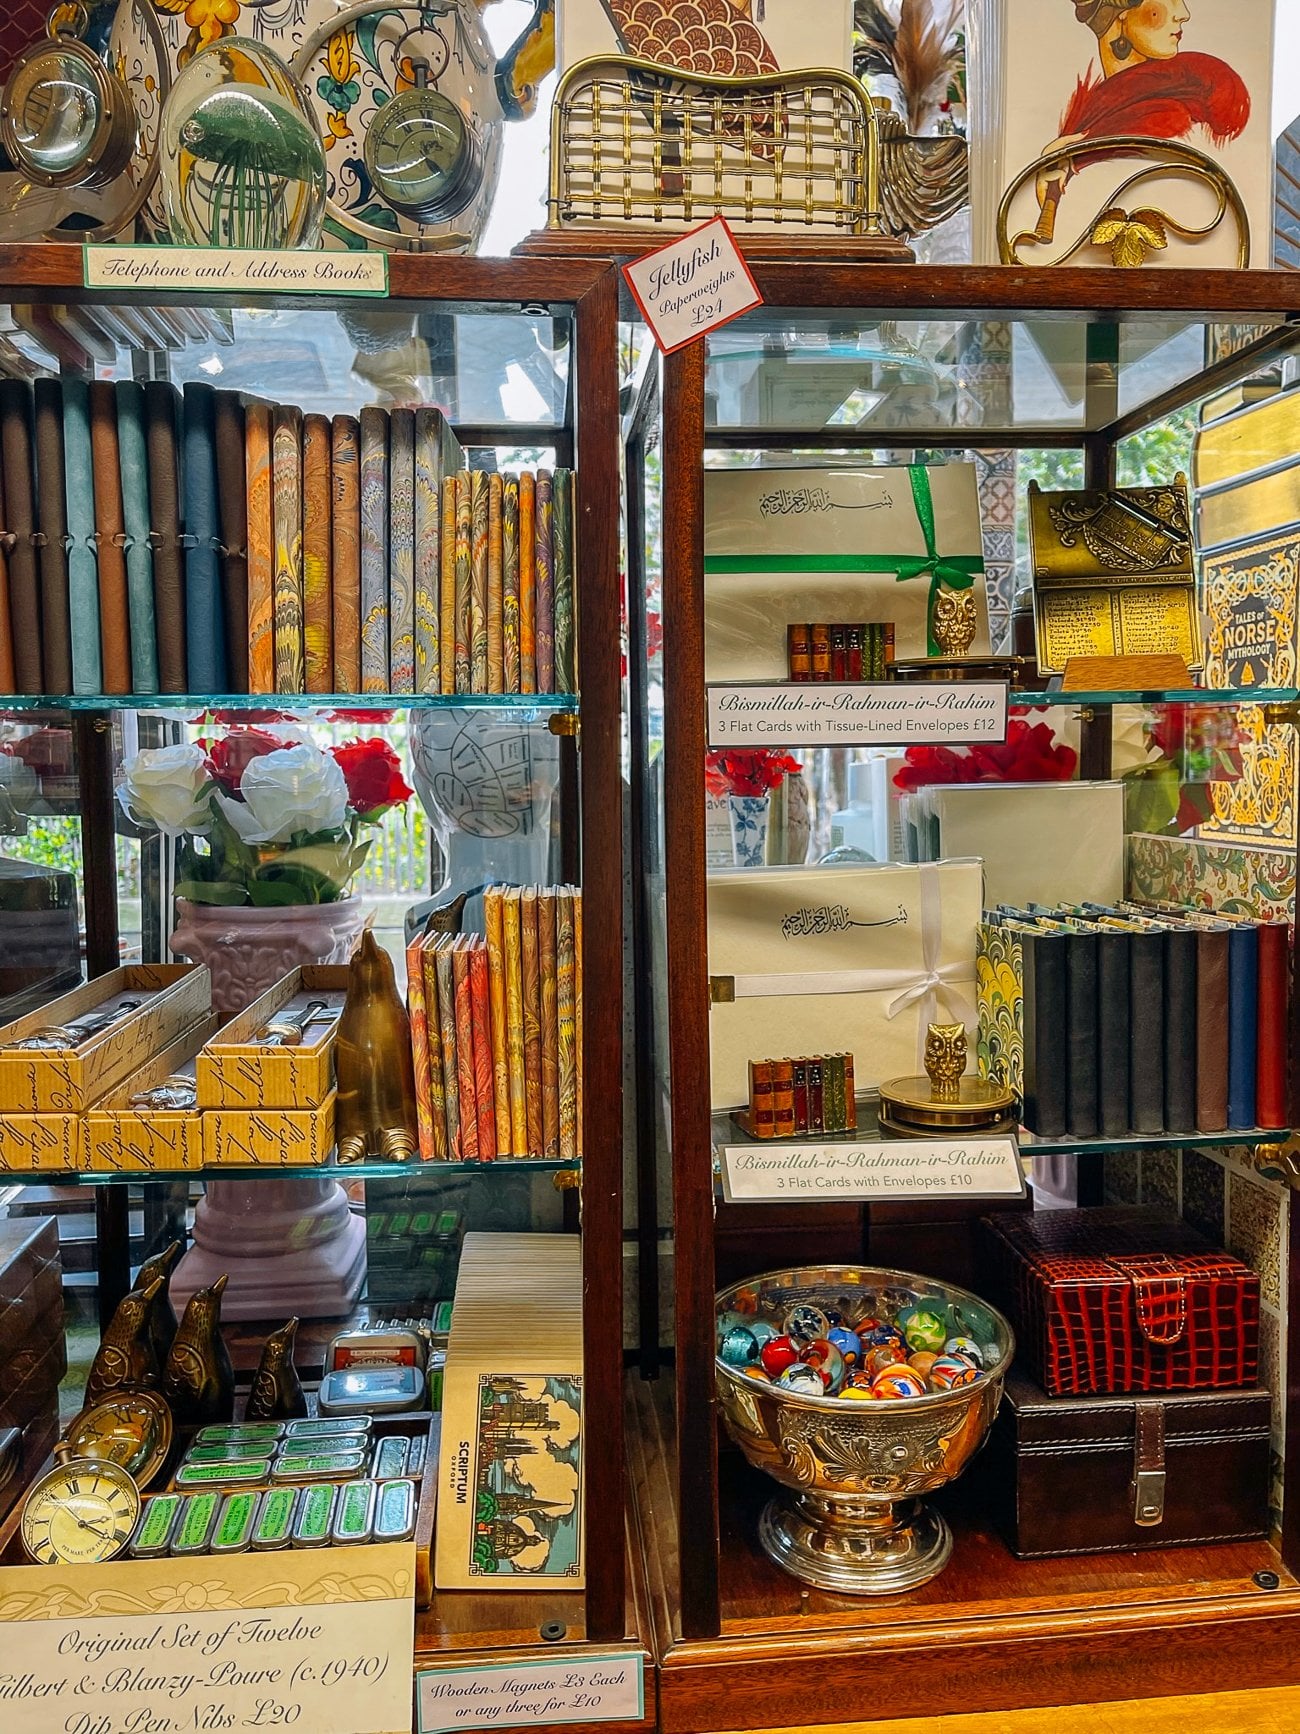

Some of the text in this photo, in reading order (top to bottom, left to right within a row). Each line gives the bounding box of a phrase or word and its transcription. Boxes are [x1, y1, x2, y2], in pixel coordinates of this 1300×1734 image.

[102, 259, 373, 283] Telephone and Address Books
[648, 239, 721, 301] Jellyfish
[659, 270, 735, 317] Paperweights
[690, 297, 723, 328] £24
[1235, 611, 1265, 624] TALES OF
[1224, 619, 1276, 649] NORSE
[1227, 643, 1271, 660] MYTHOLOGY
[718, 692, 996, 712] Bismillah-ir-Rahman-ir-Rahim
[718, 718, 995, 734] 3 Flat Cards with Tissue-Lined Envelopes £12
[735, 1149, 1009, 1171] Bismillah-ir-Rahman-ir-Rahim
[777, 1174, 973, 1189] 3 Flat Cards with Envelopes £10
[456, 1441, 470, 1504] SCRIPTUM
[57, 1616, 324, 1663] Original Set of Twelve
[73, 1676, 95, 1695] &
[101, 1660, 283, 1699] Blanzy-Poure
[288, 1651, 390, 1692] (c.1940)
[431, 1671, 627, 1699] Wooden Magnets £3 Each
[64, 1698, 302, 1734] Dip Pen Nibs £20
[455, 1693, 602, 1719] or any three for £10
